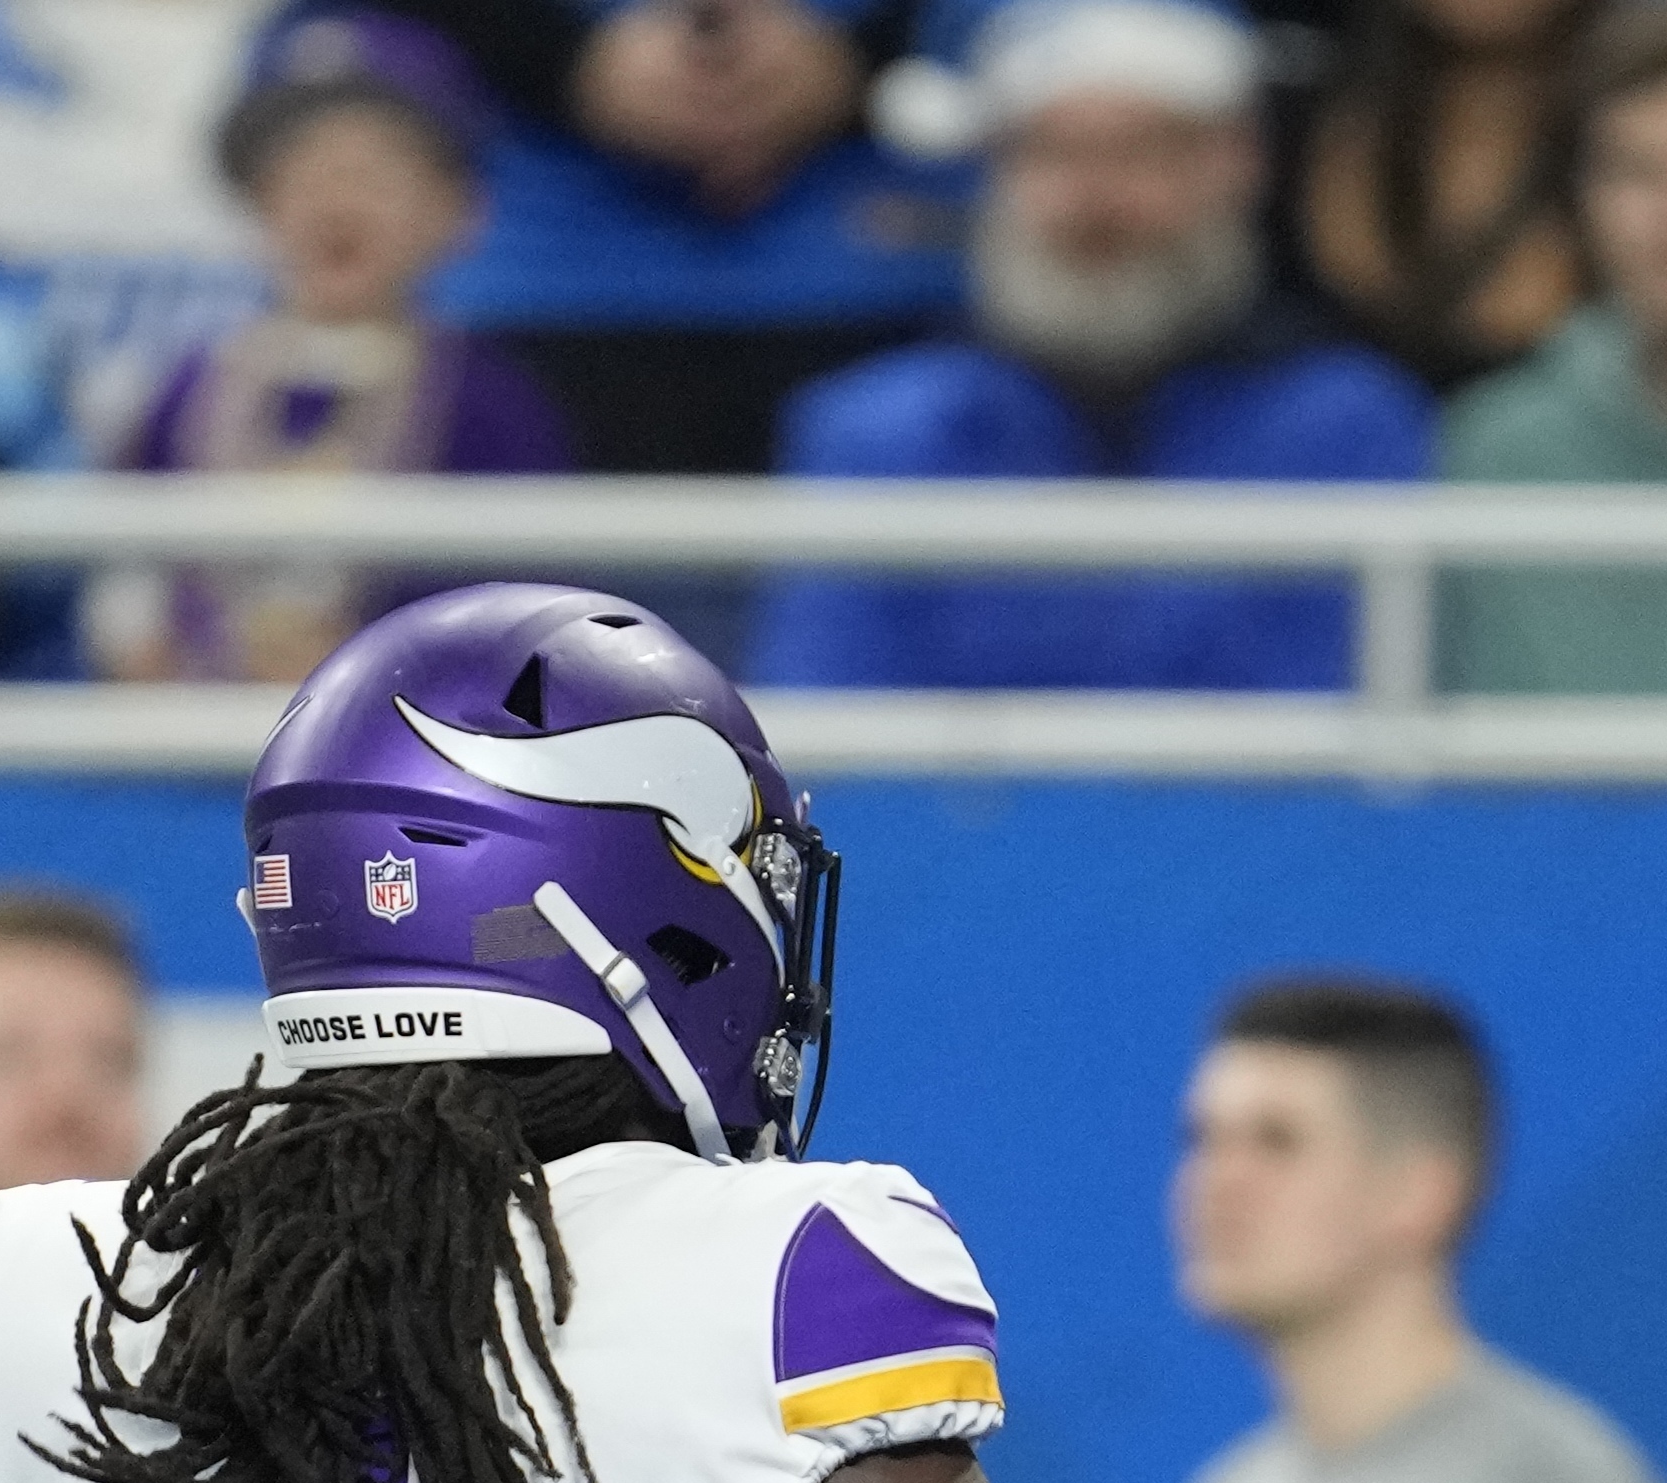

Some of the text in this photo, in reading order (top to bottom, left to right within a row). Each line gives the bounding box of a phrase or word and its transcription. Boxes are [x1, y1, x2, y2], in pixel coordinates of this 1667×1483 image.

[374, 882, 410, 910] NFL
[277, 1011, 463, 1046] CHOOSE LOVE
